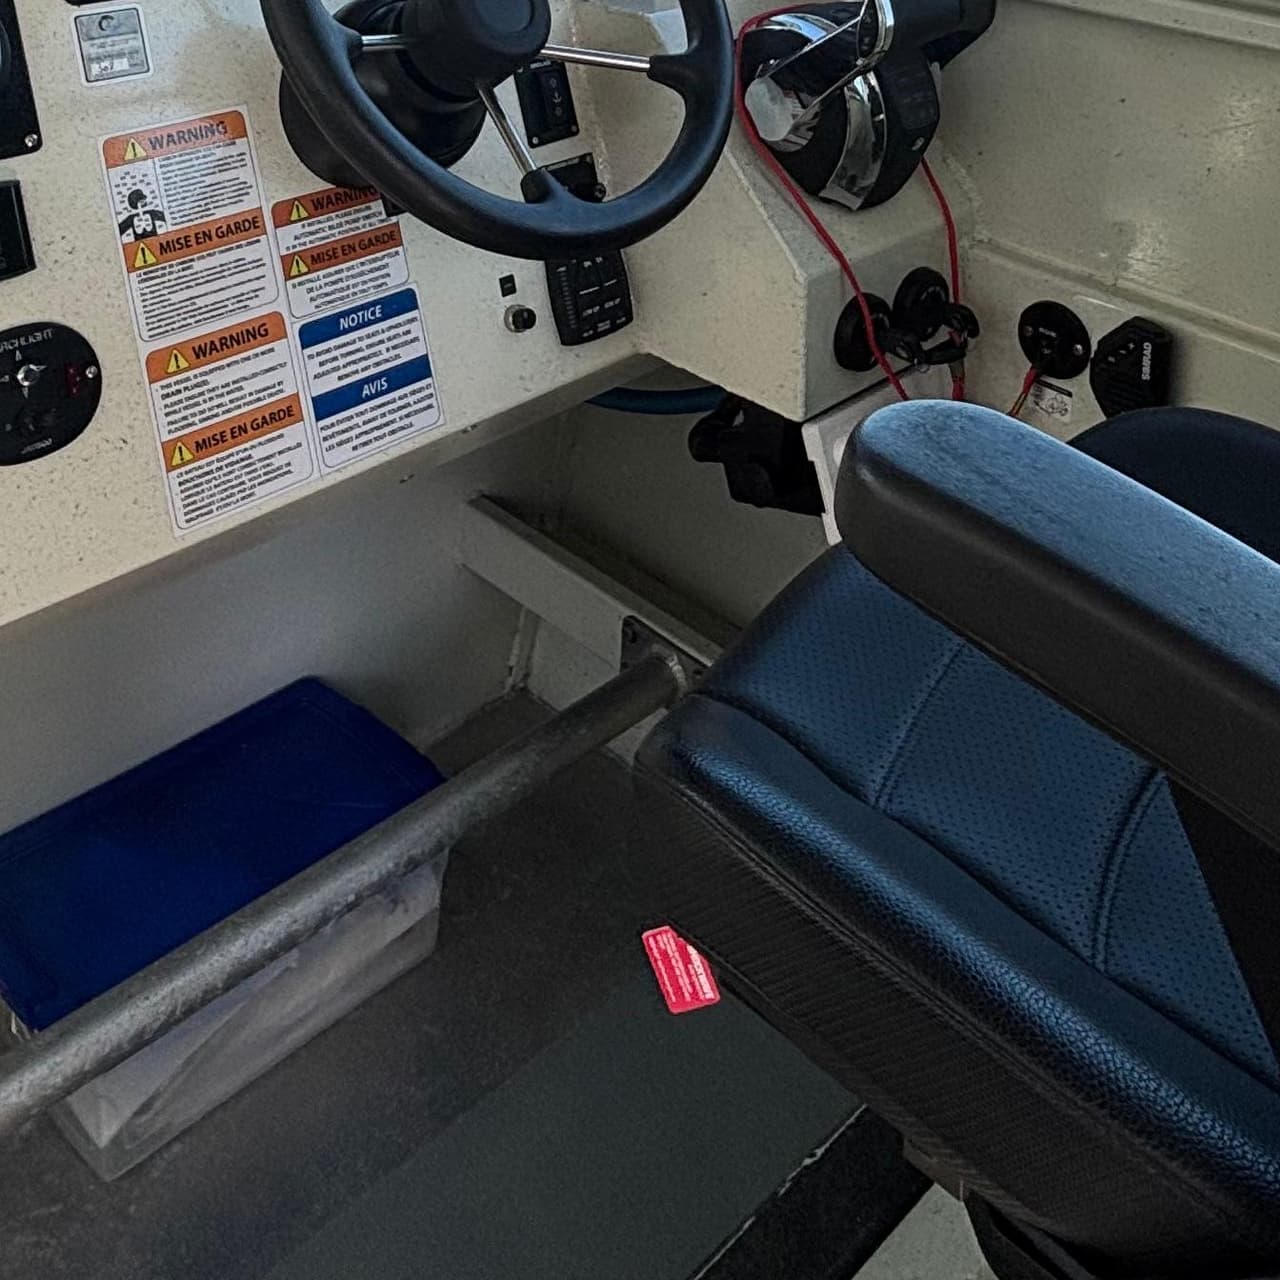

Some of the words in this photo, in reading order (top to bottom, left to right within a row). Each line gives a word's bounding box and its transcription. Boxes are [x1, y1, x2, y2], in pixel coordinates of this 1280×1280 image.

[148, 120, 228, 150] WARNING
[158, 234, 191, 255] MISE
[194, 228, 212, 245] EN
[214, 215, 260, 240] GARDE
[309, 246, 339, 265] MISE
[340, 241, 356, 256] EN
[357, 230, 397, 251] GARDE
[338, 304, 383, 330] NOTICE
[192, 322, 269, 360] WARNING
[1141, 342, 1152, 380] SIMRAD
[360, 376, 388, 398] AVIS
[194, 430, 227, 453] MISE
[229, 422, 248, 439] EN
[249, 404, 294, 431] GARDE
